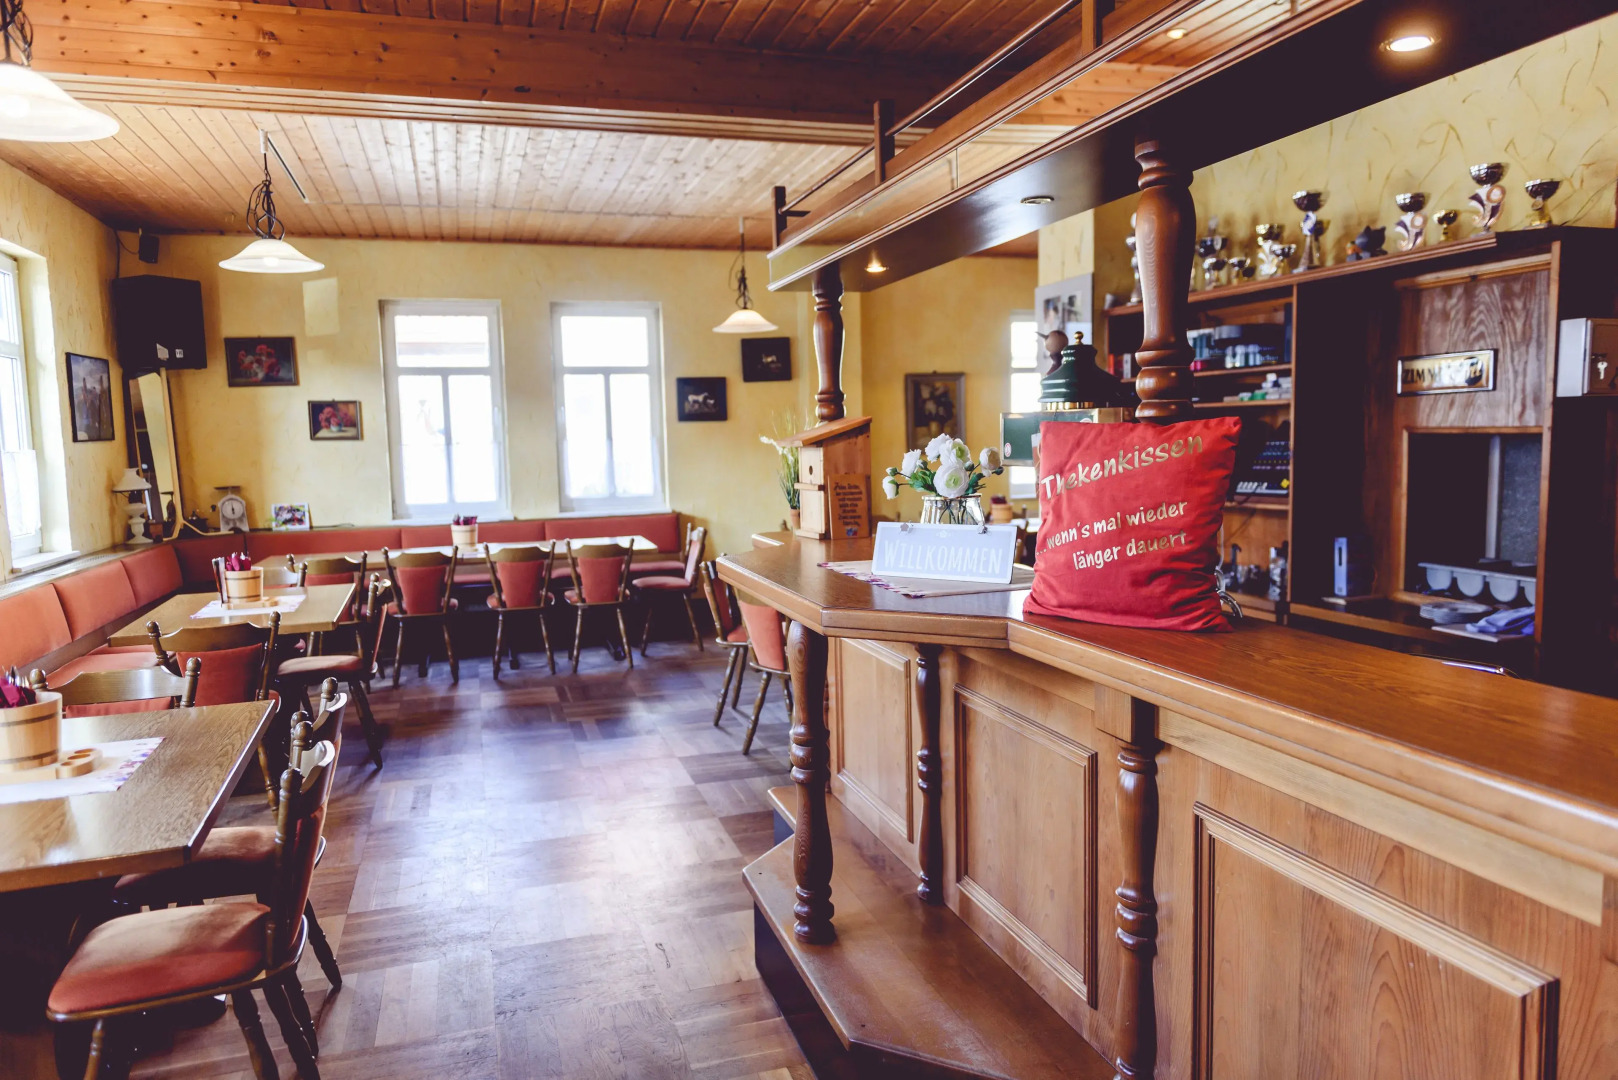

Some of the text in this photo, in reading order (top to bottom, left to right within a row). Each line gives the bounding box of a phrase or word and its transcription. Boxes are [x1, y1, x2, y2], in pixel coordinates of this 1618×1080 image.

[1041, 436, 1203, 500] Thekenkissen
[1093, 512, 1121, 535] mal
[1126, 501, 1188, 526] wieder
[884, 539, 1003, 574] WILLKOMMEN
[1072, 545, 1121, 570] länger
